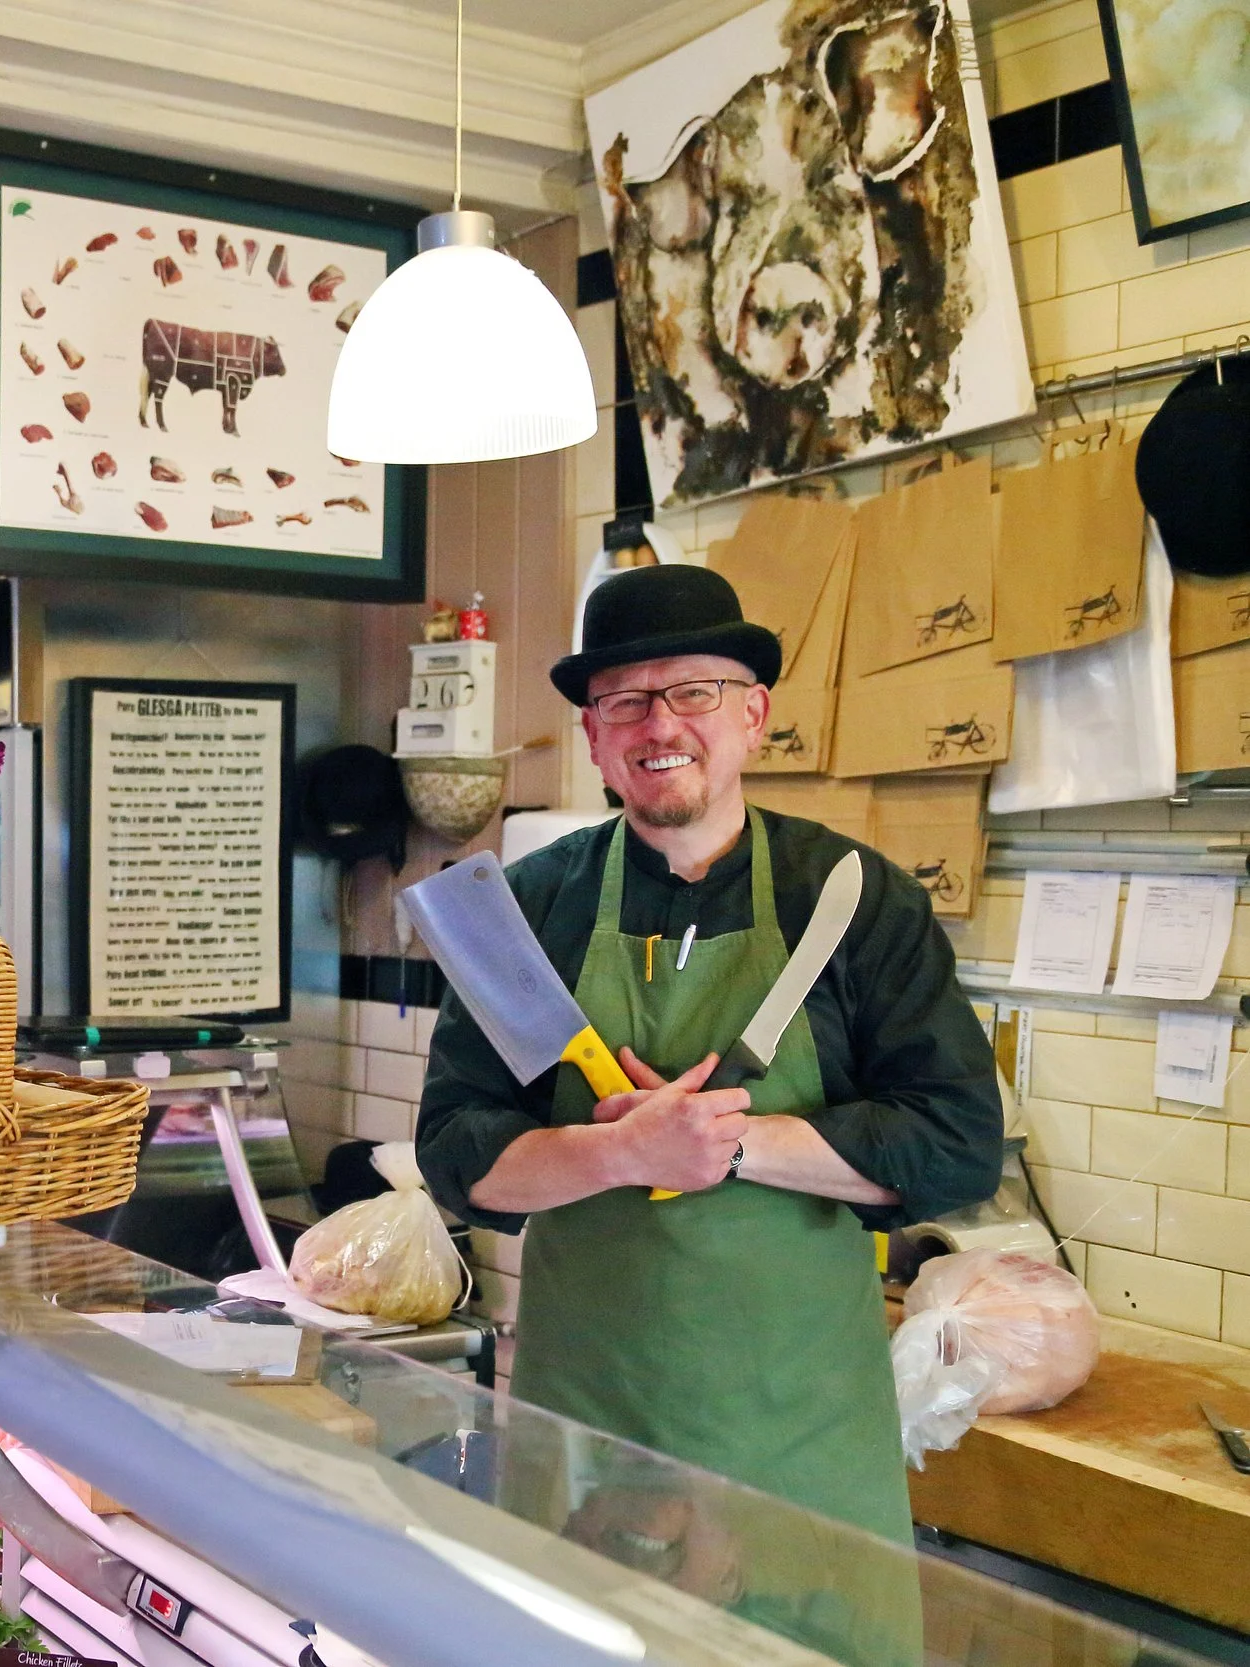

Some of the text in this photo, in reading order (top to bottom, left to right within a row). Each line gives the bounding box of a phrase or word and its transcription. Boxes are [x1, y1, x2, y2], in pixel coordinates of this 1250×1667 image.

[137, 698, 182, 717] GLESGA
[184, 701, 222, 717] PATTER
[17, 1651, 53, 1667] Chicken
